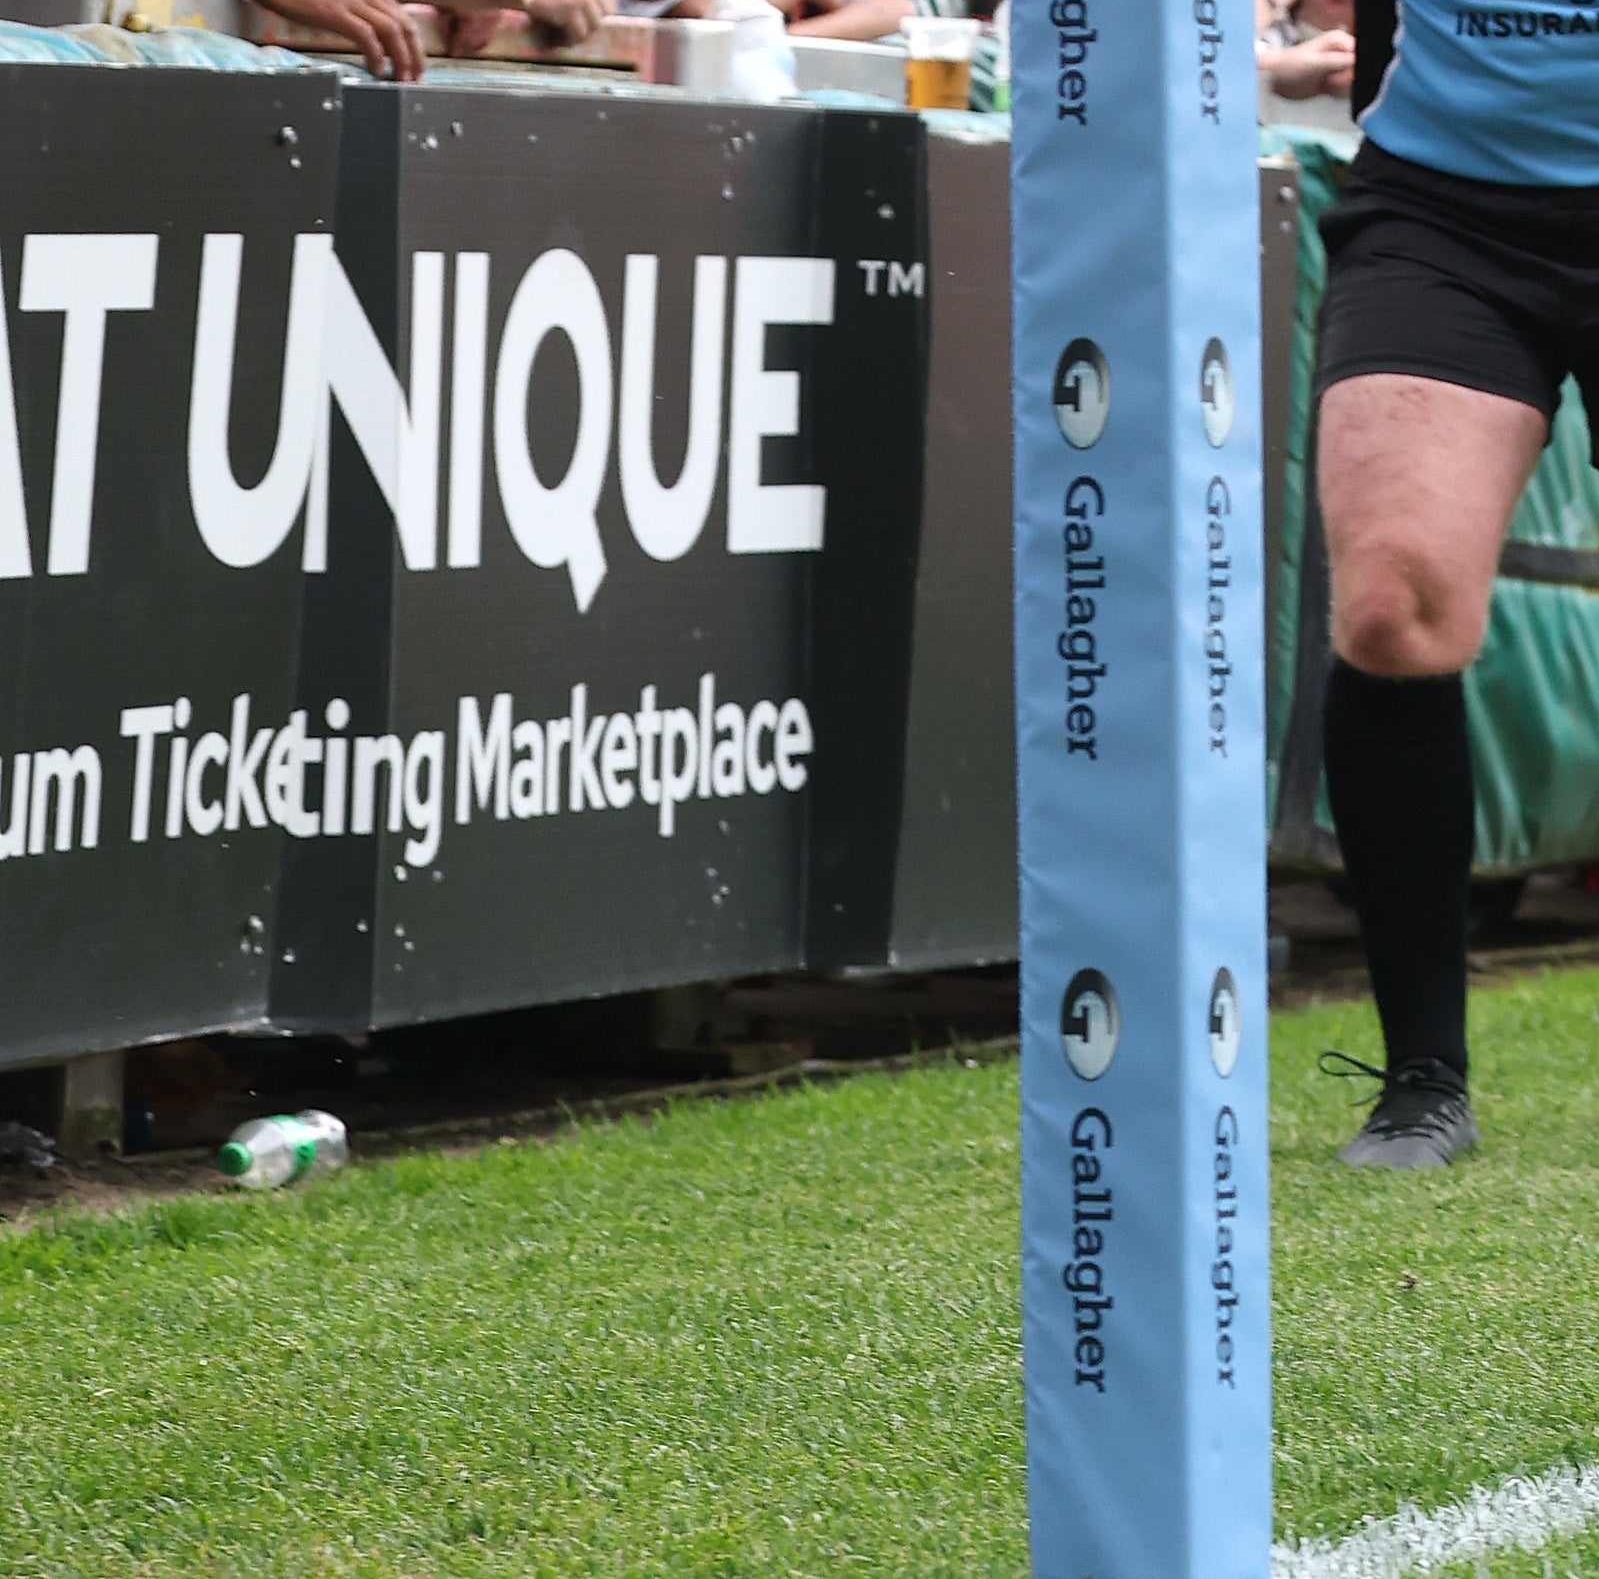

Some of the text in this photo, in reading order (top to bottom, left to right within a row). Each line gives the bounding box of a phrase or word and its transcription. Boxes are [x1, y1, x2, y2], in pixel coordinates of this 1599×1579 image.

[187, 232, 837, 615] UNIQUE
[1057, 475, 1107, 761] Gallagher
[1203, 475, 1232, 759] Gallagher
[119, 693, 446, 868] Ticketing
[455, 670, 815, 838] Marketplace
[1062, 1107, 1114, 1394] Gallagher
[1211, 1105, 1239, 1390] Gallagher
